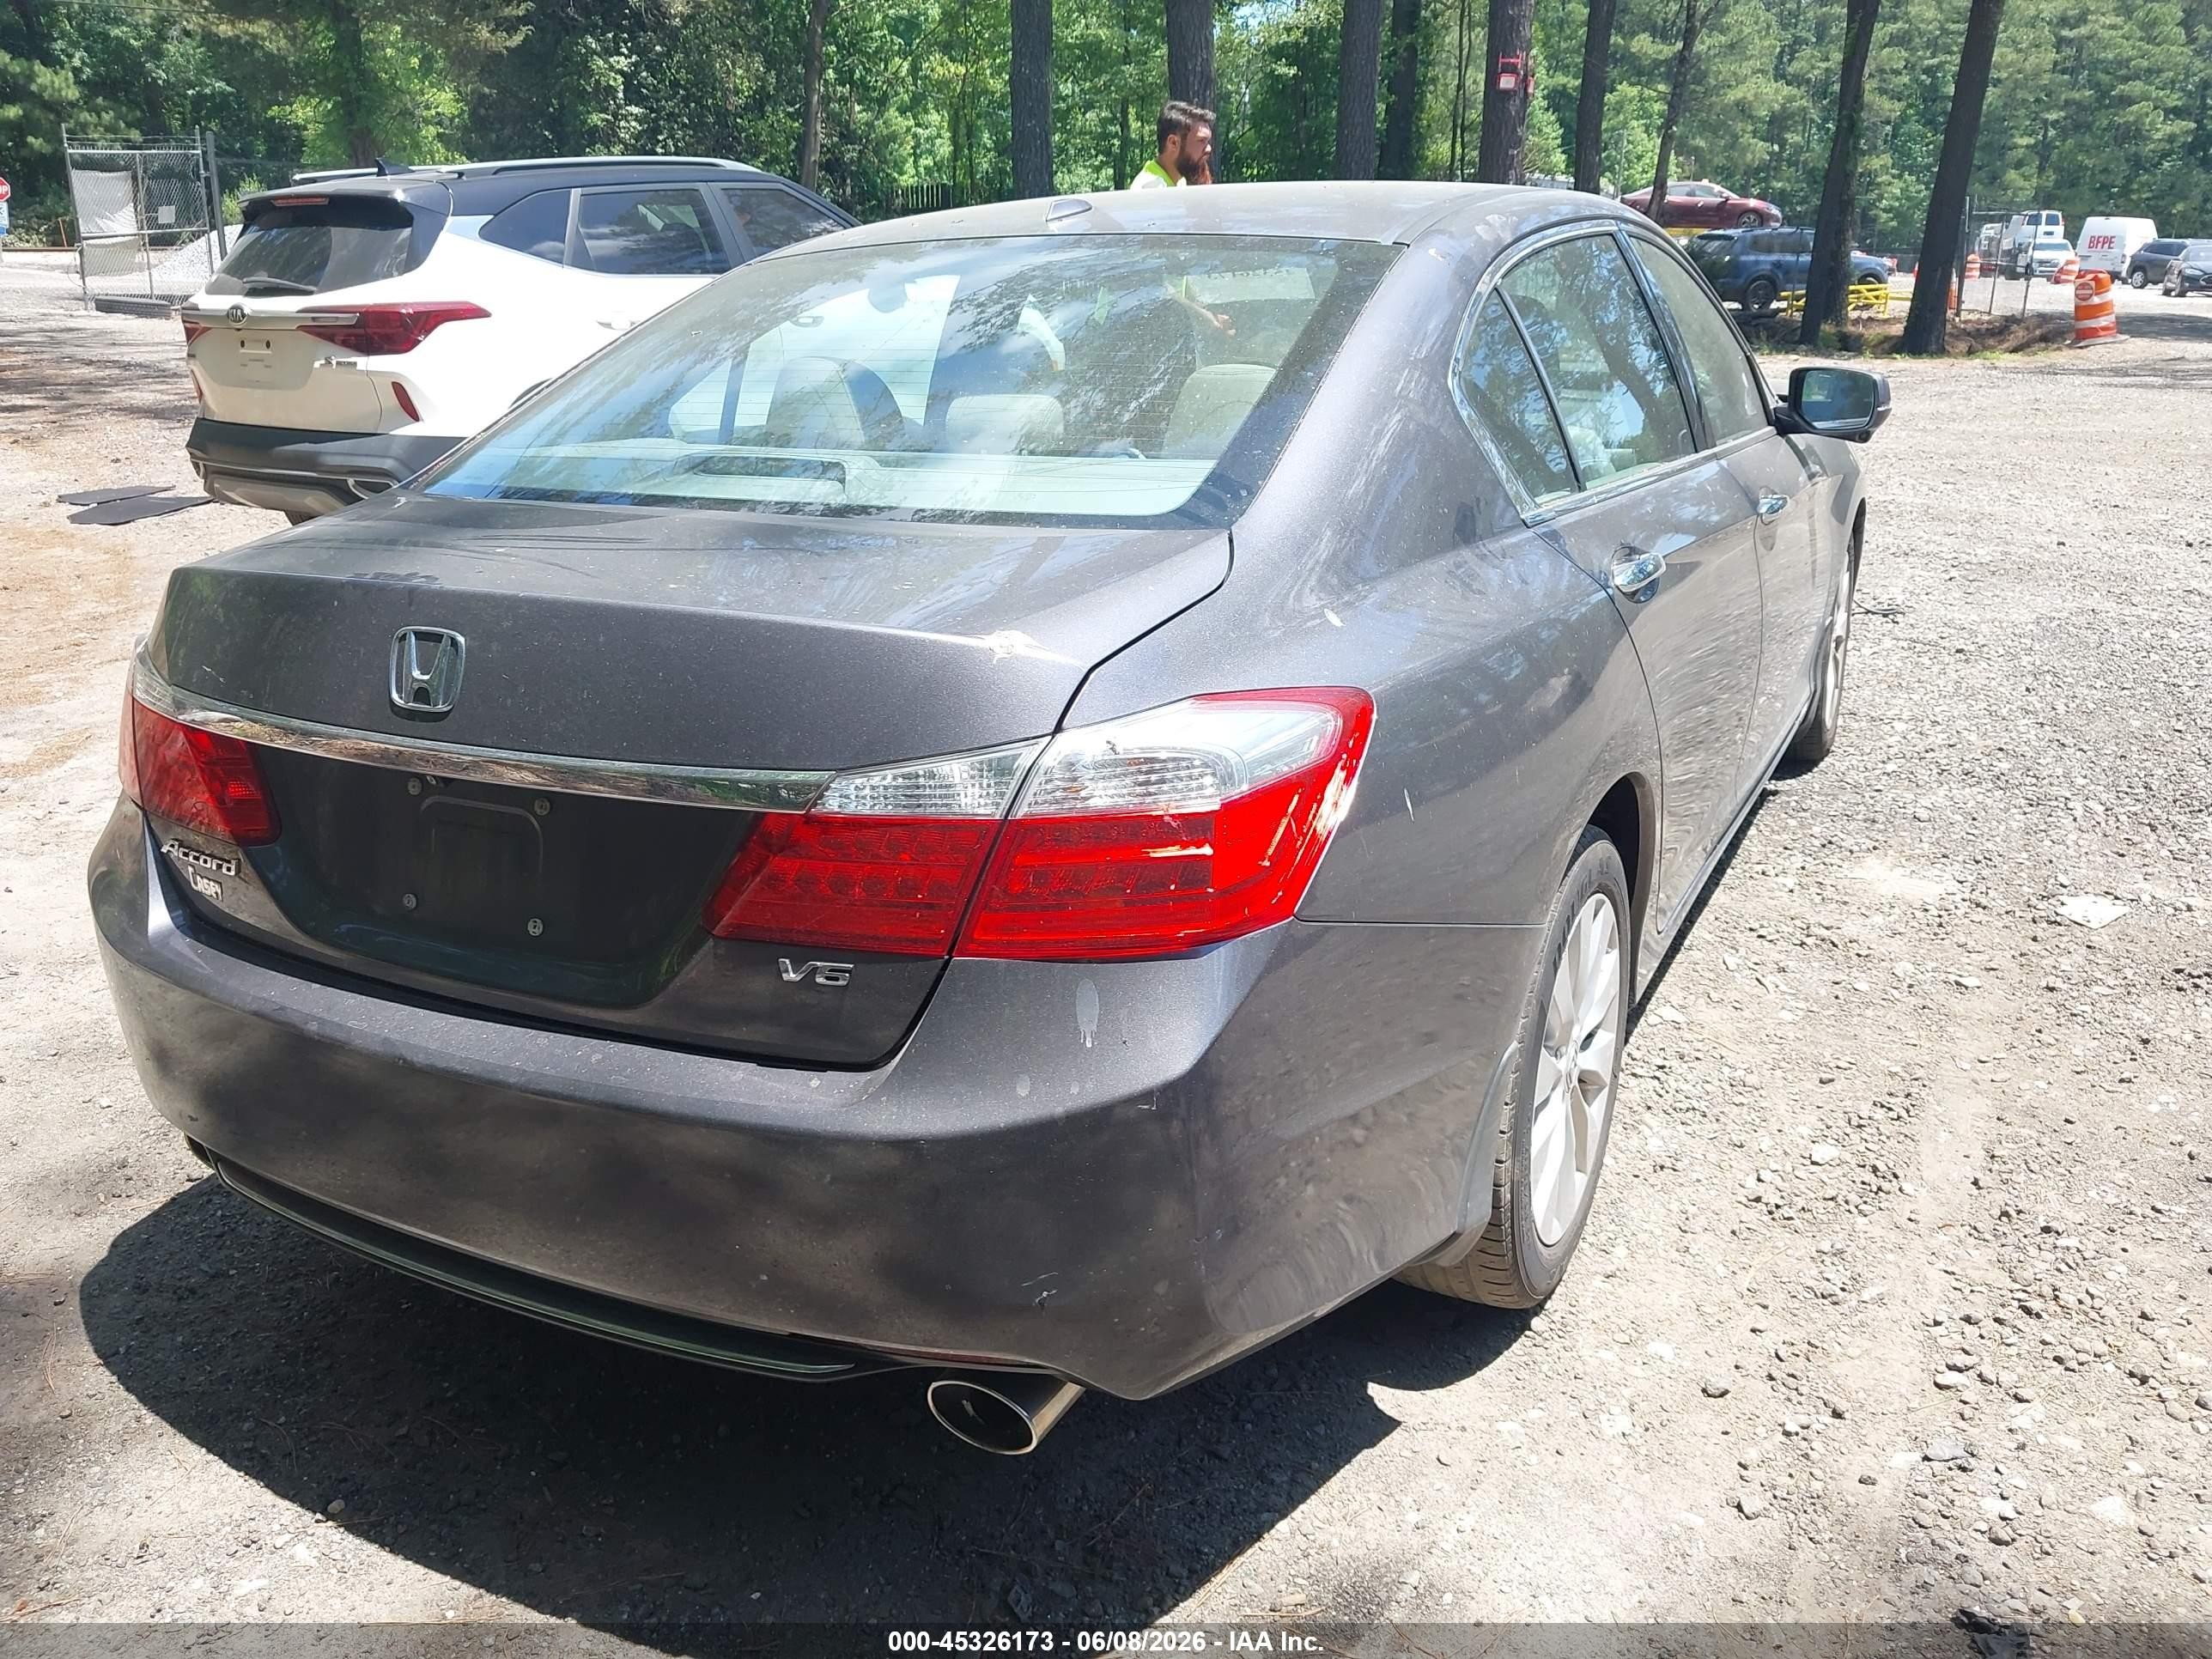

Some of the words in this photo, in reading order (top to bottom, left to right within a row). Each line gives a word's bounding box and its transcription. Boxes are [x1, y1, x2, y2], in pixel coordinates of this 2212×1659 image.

[2087, 235, 2116, 250] BFPE
[228, 308, 243, 321] KIA
[161, 839, 240, 876] Accord
[778, 957, 854, 986] V6
